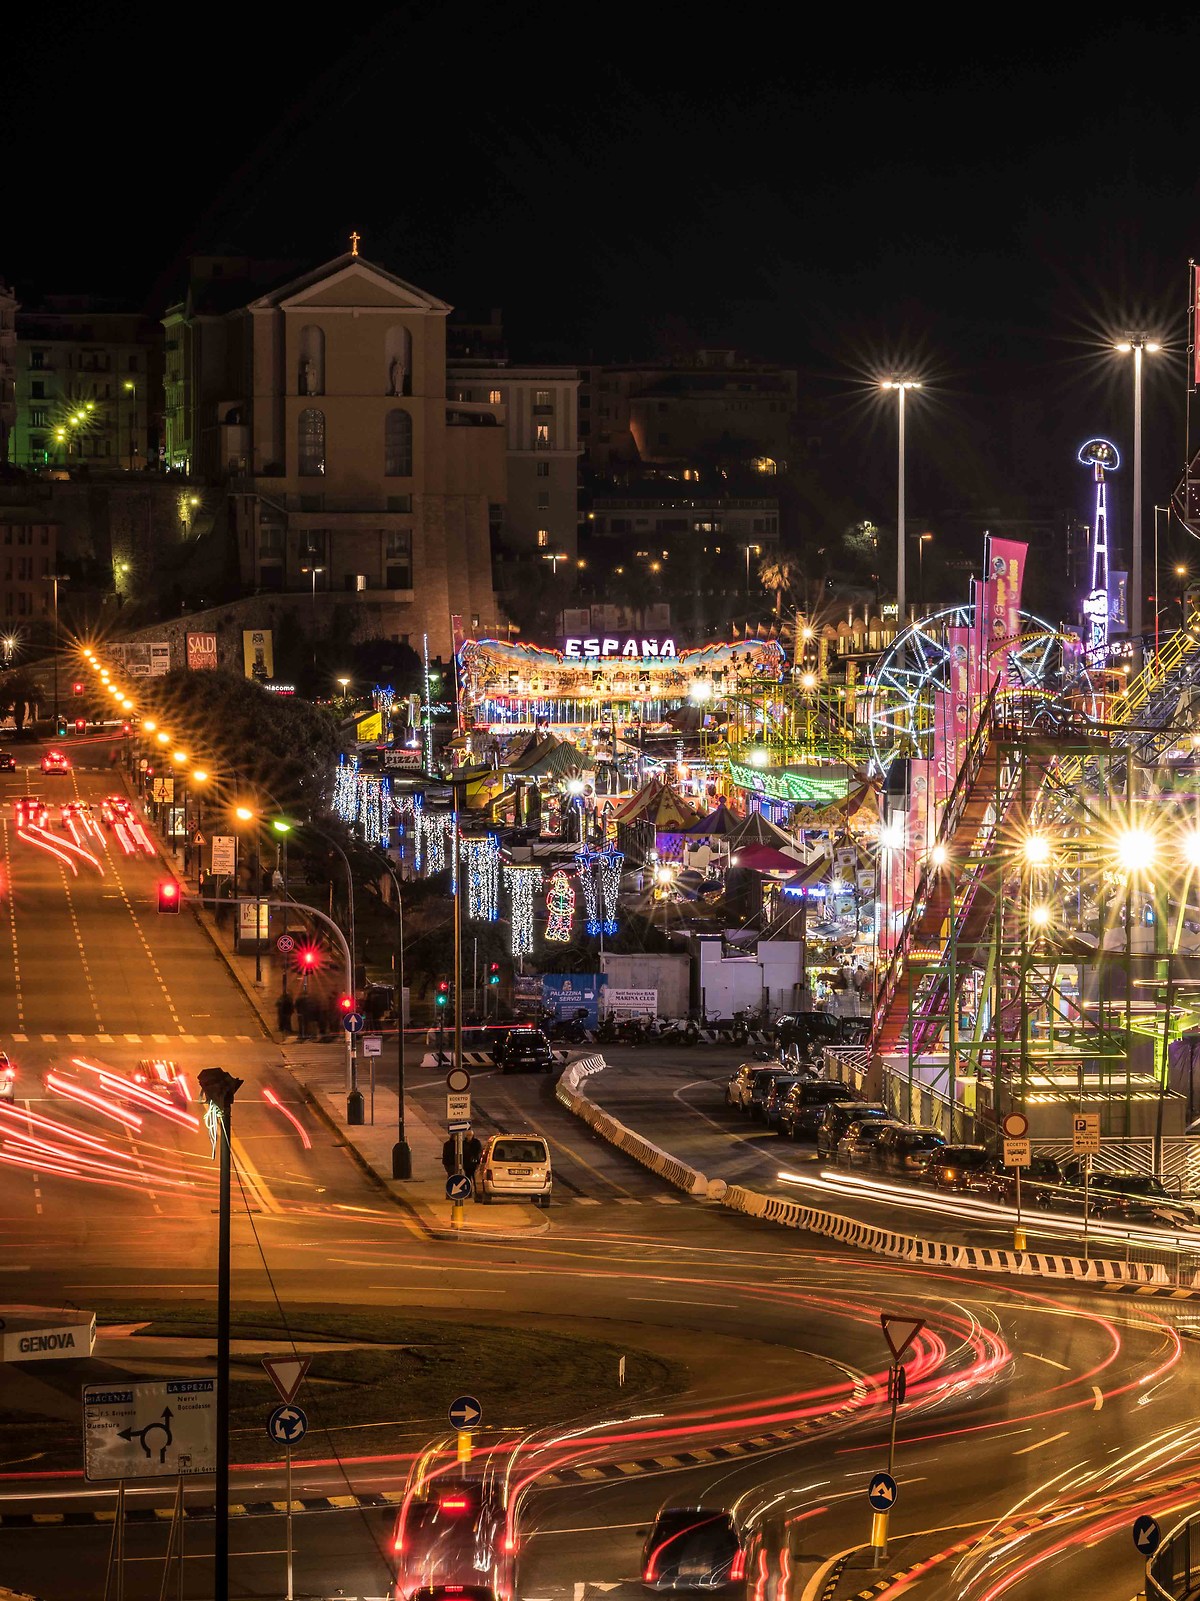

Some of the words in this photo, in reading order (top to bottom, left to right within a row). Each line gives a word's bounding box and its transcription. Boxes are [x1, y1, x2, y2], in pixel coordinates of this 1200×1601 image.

[188, 636, 217, 654] SALDI
[565, 639, 676, 657] ESPAÑA
[189, 654, 218, 665] FASHION
[386, 756, 420, 765] PIZZA
[937, 738, 955, 782] Picci
[20, 1333, 75, 1353] GENOVA
[168, 1384, 179, 1392] LA
[181, 1382, 213, 1391] SPEZIA
[86, 1393, 132, 1403] PIACENZA
